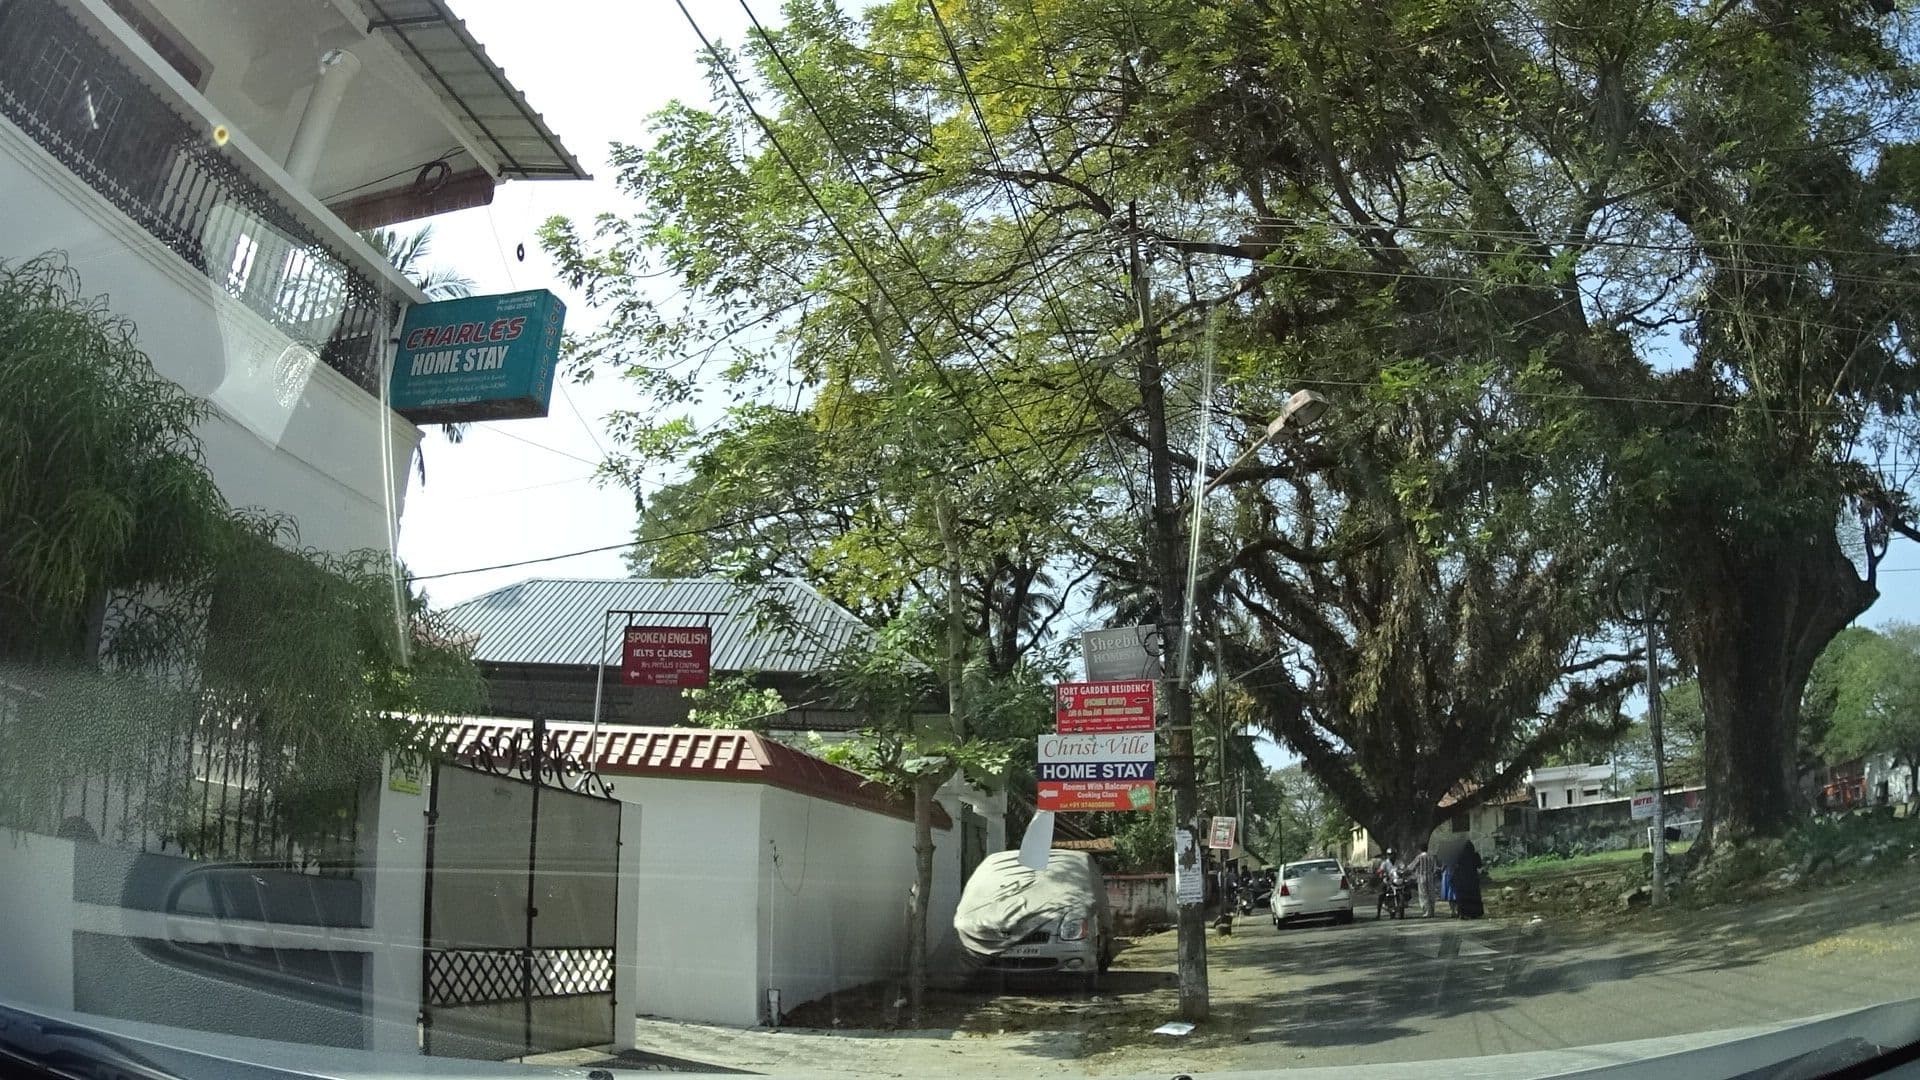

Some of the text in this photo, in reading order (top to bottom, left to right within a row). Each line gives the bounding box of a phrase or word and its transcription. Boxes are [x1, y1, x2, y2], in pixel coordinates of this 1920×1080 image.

[406, 316, 527, 350] CHARLES
[410, 345, 510, 377] HOME STAY
[627, 632, 708, 645] SPOKEN ENGLISH
[1090, 634, 1140, 652] Sheeba
[633, 648, 693, 658] IELTS CLASSES
[1060, 683, 1150, 696] FORT GARDEN RESIDENCY
[1043, 763, 1148, 779] HOME STAY
[1062, 782, 1133, 791] Rooms With Balcony
[1077, 791, 1101, 799] Cooking
